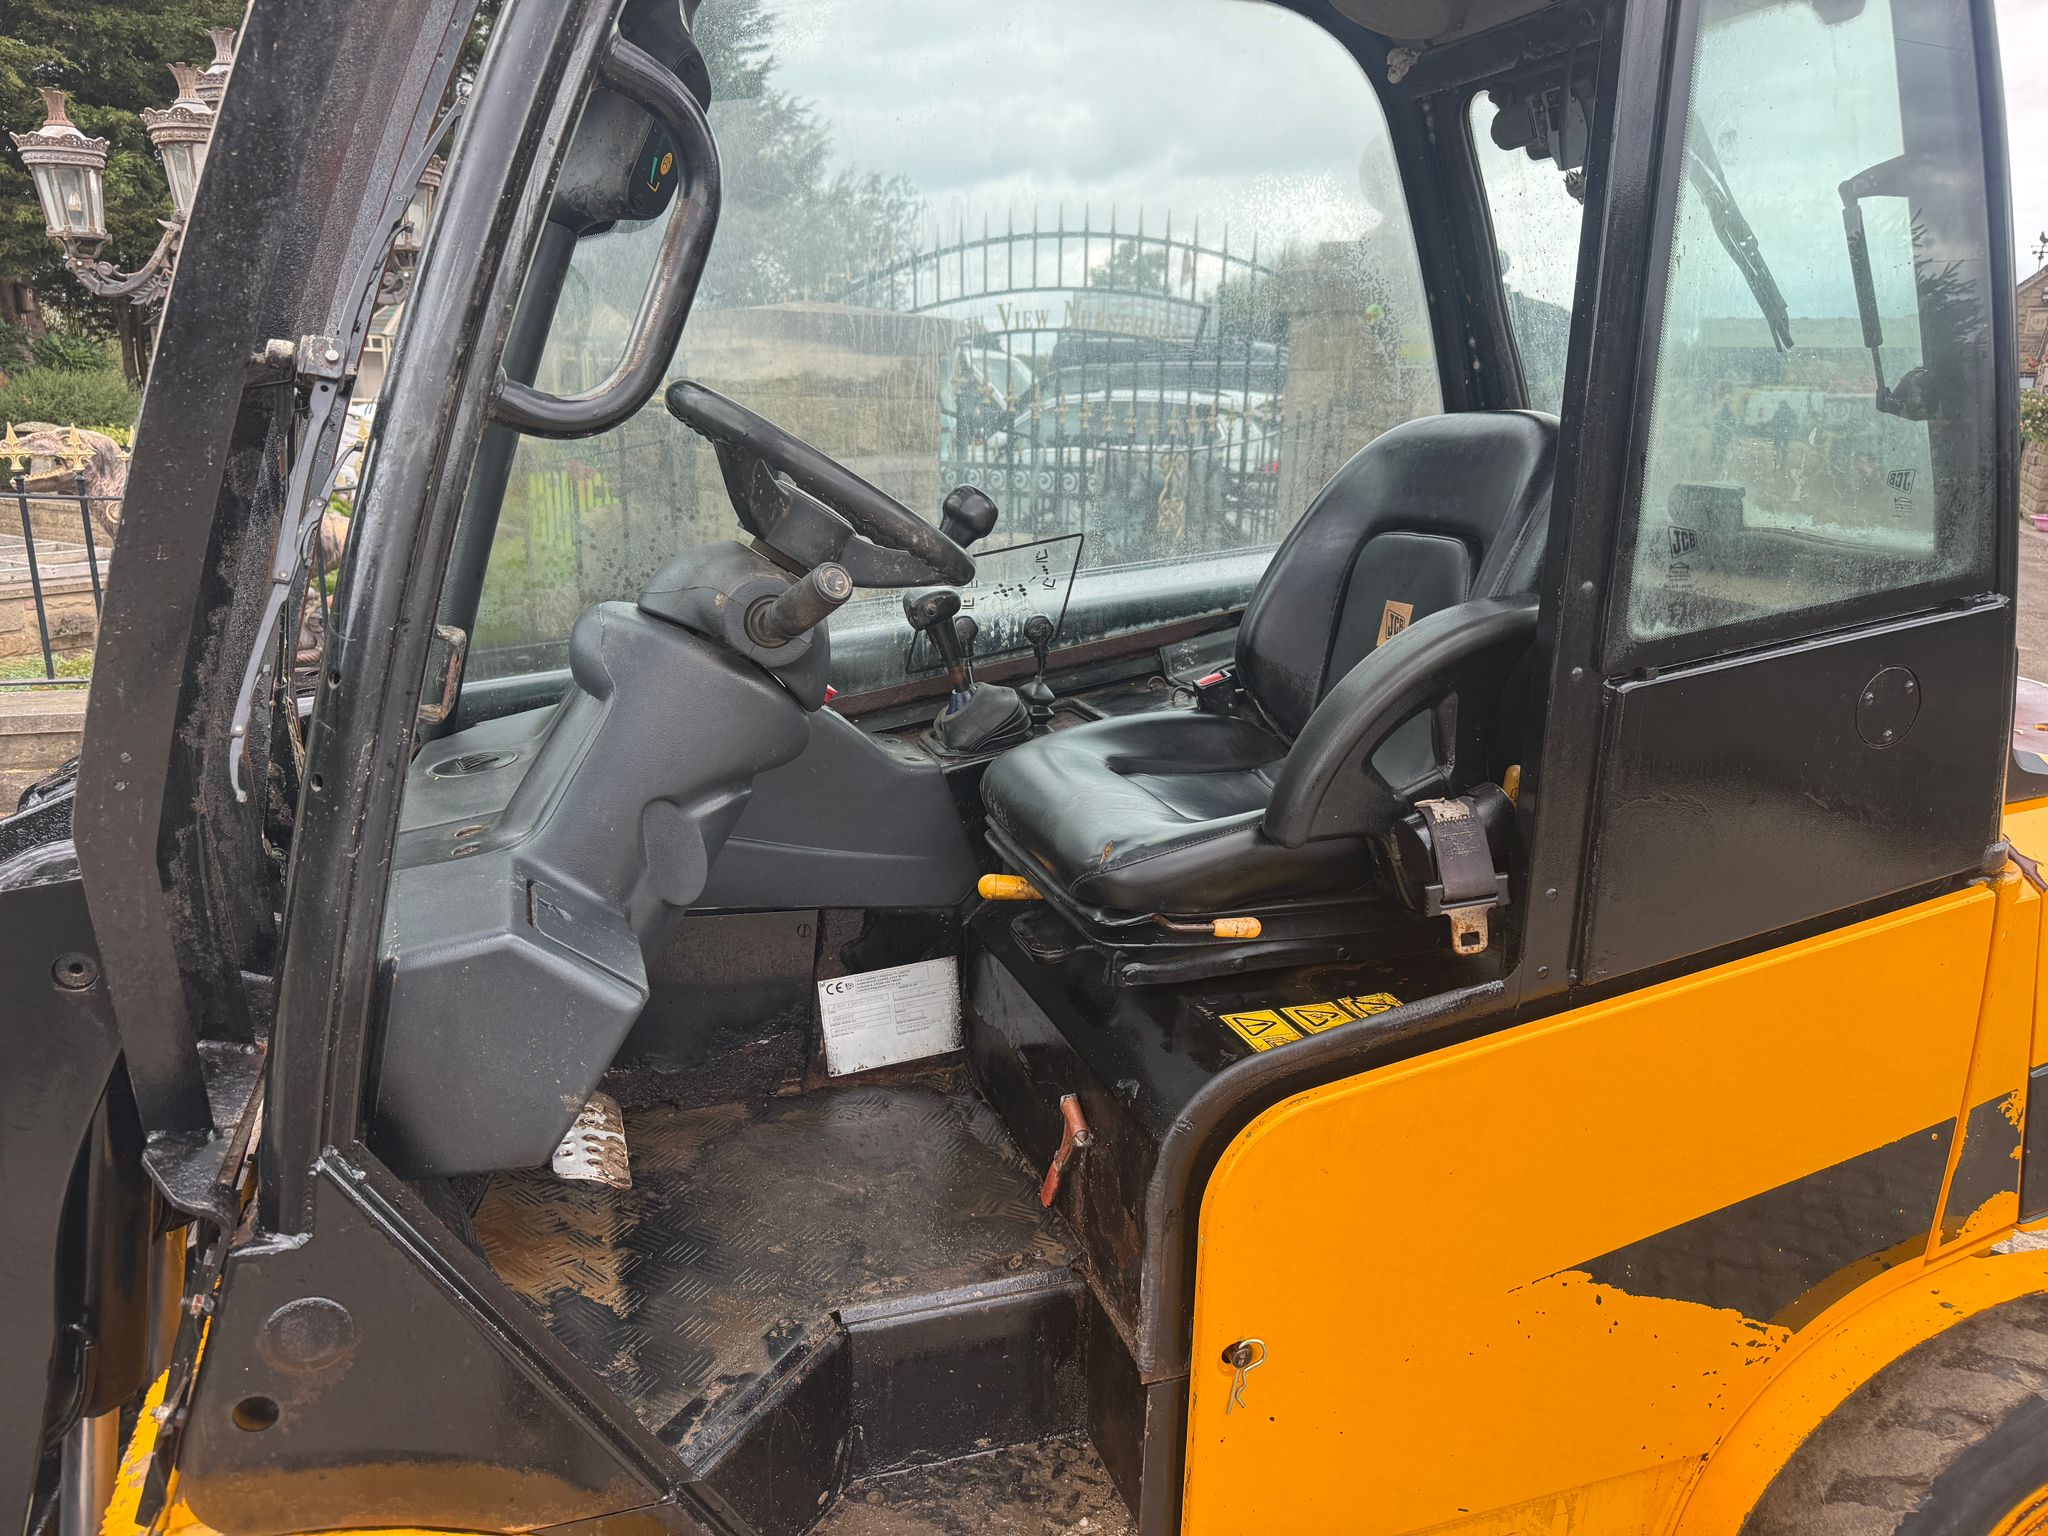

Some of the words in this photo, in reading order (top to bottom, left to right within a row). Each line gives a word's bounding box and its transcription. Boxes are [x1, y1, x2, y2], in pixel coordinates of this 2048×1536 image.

[997, 302, 1050, 331] VIEW
[1671, 529, 1696, 555] JCB
[1387, 612, 1405, 637] JCB
[826, 981, 844, 995] CE
